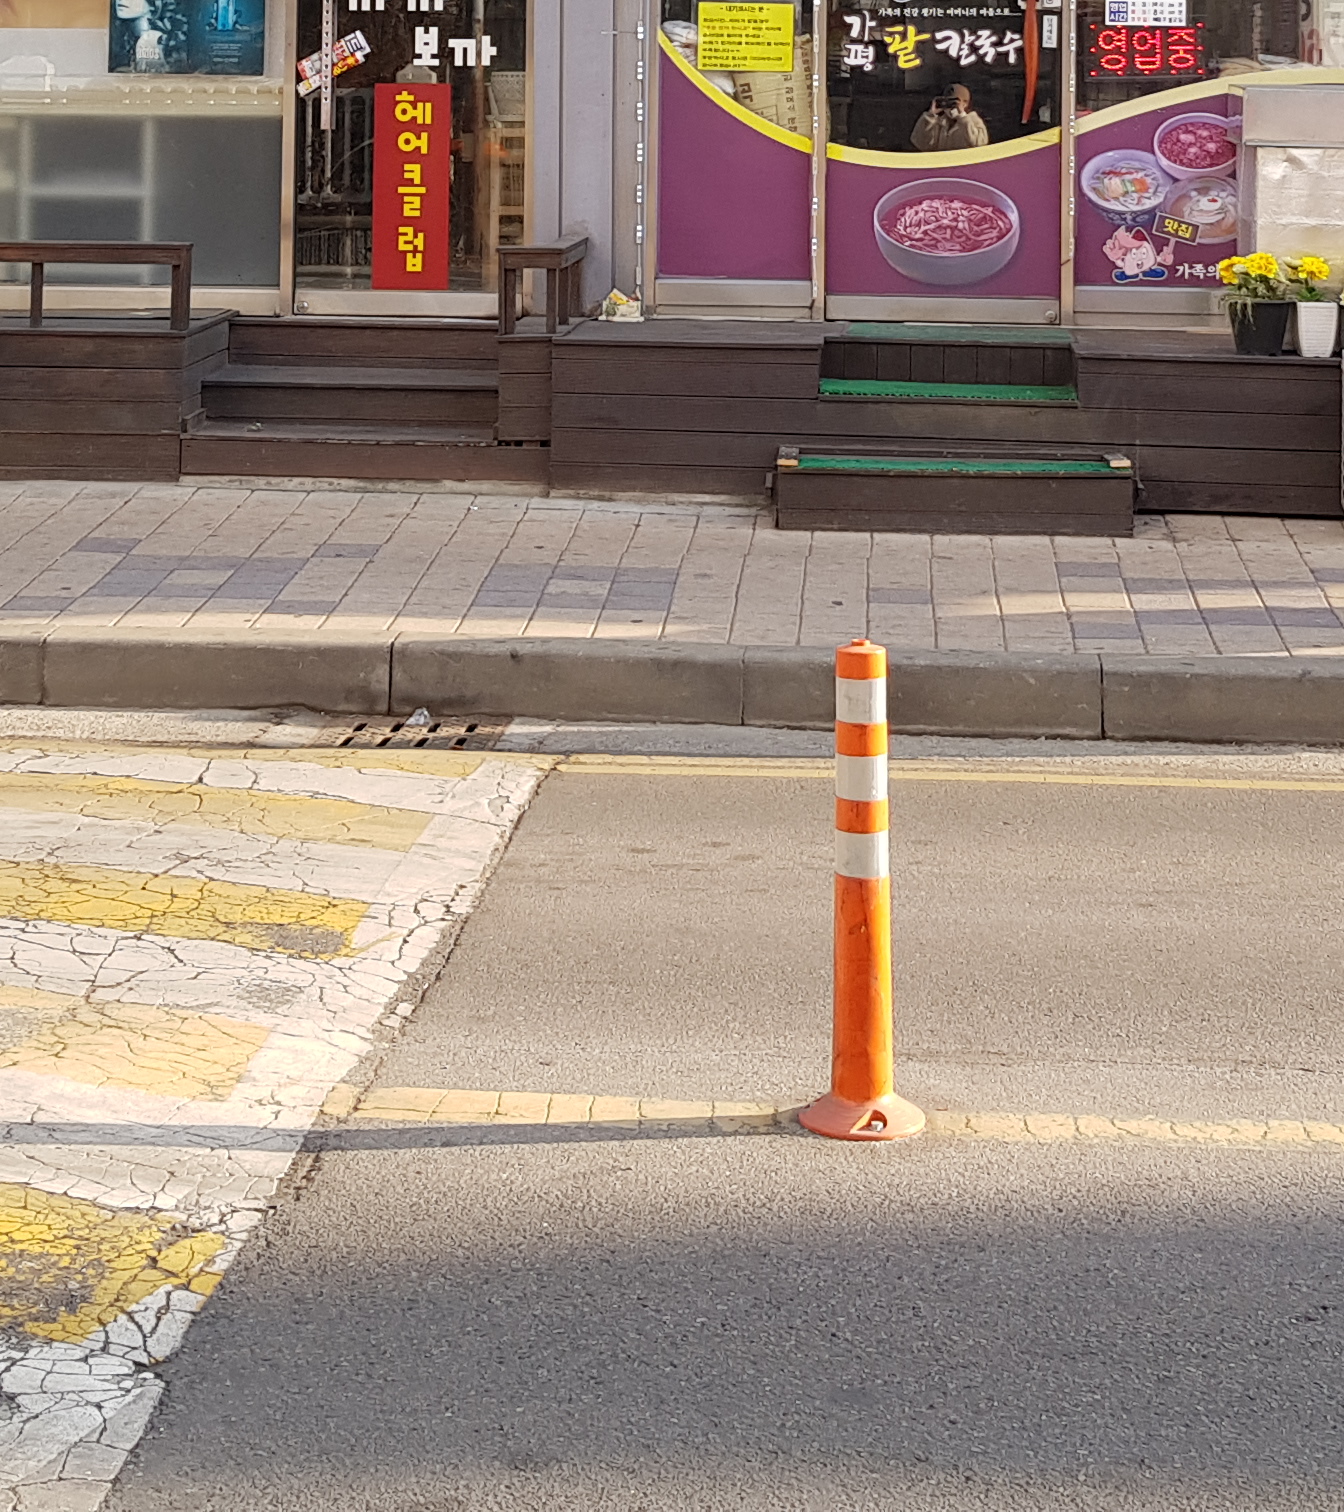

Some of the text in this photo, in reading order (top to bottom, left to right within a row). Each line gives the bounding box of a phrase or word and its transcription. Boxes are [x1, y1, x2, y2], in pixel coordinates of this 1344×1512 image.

[413, 26, 497, 67] 보까
[843, 10, 876, 71] 가평
[883, 25, 1024, 69] 팥 칼국수
[1098, 29, 1196, 70] 영업중
[394, 90, 433, 273] 헤어클럽
[1163, 218, 1194, 239] 맛집
[1174, 263, 1220, 280] 가족의
